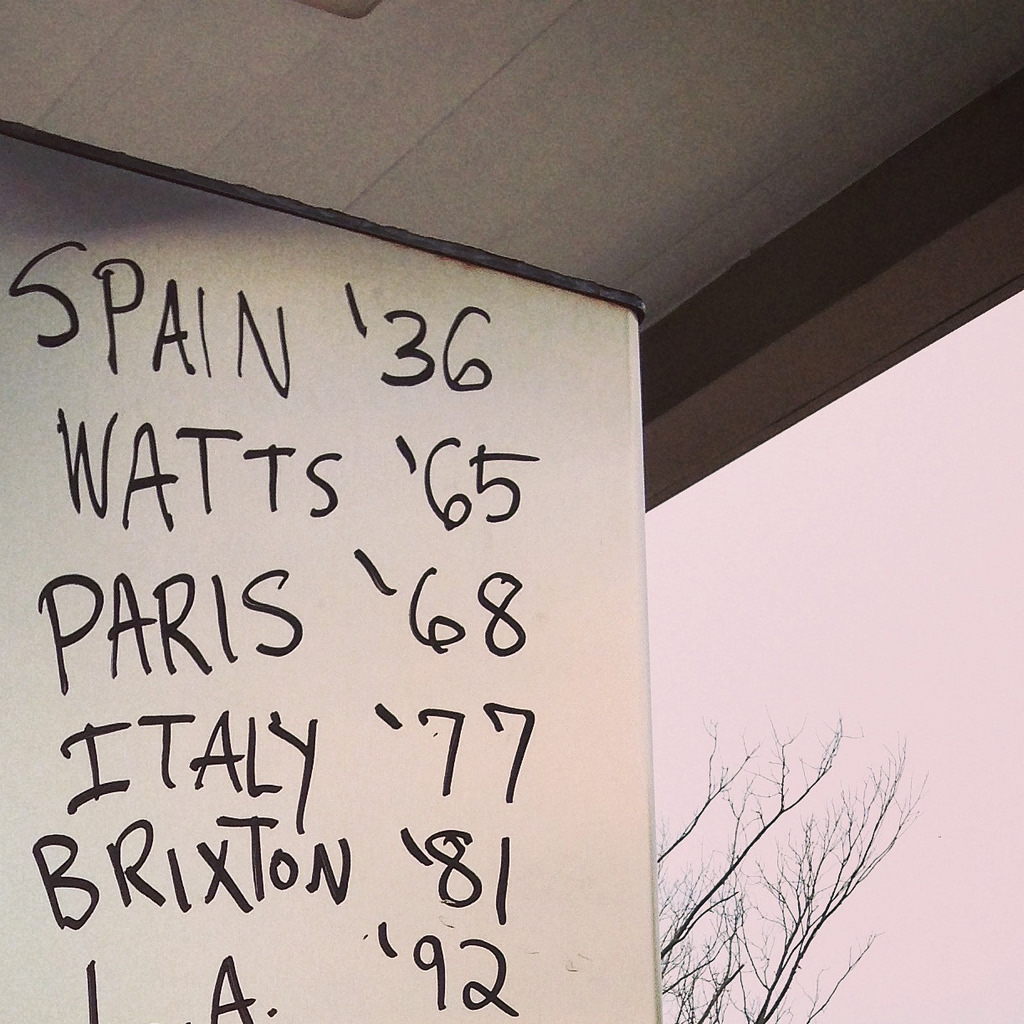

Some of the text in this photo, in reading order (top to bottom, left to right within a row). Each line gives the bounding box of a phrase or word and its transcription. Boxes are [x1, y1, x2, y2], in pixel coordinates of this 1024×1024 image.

[8, 240, 492, 399] SPAIN '36
[56, 408, 540, 532] WATTS '65
[37, 548, 526, 697] PARIS '68
[60, 702, 536, 835] ITALY '77
[32, 815, 511, 931] BRIXTON '81
[377, 922, 519, 1018] '92
